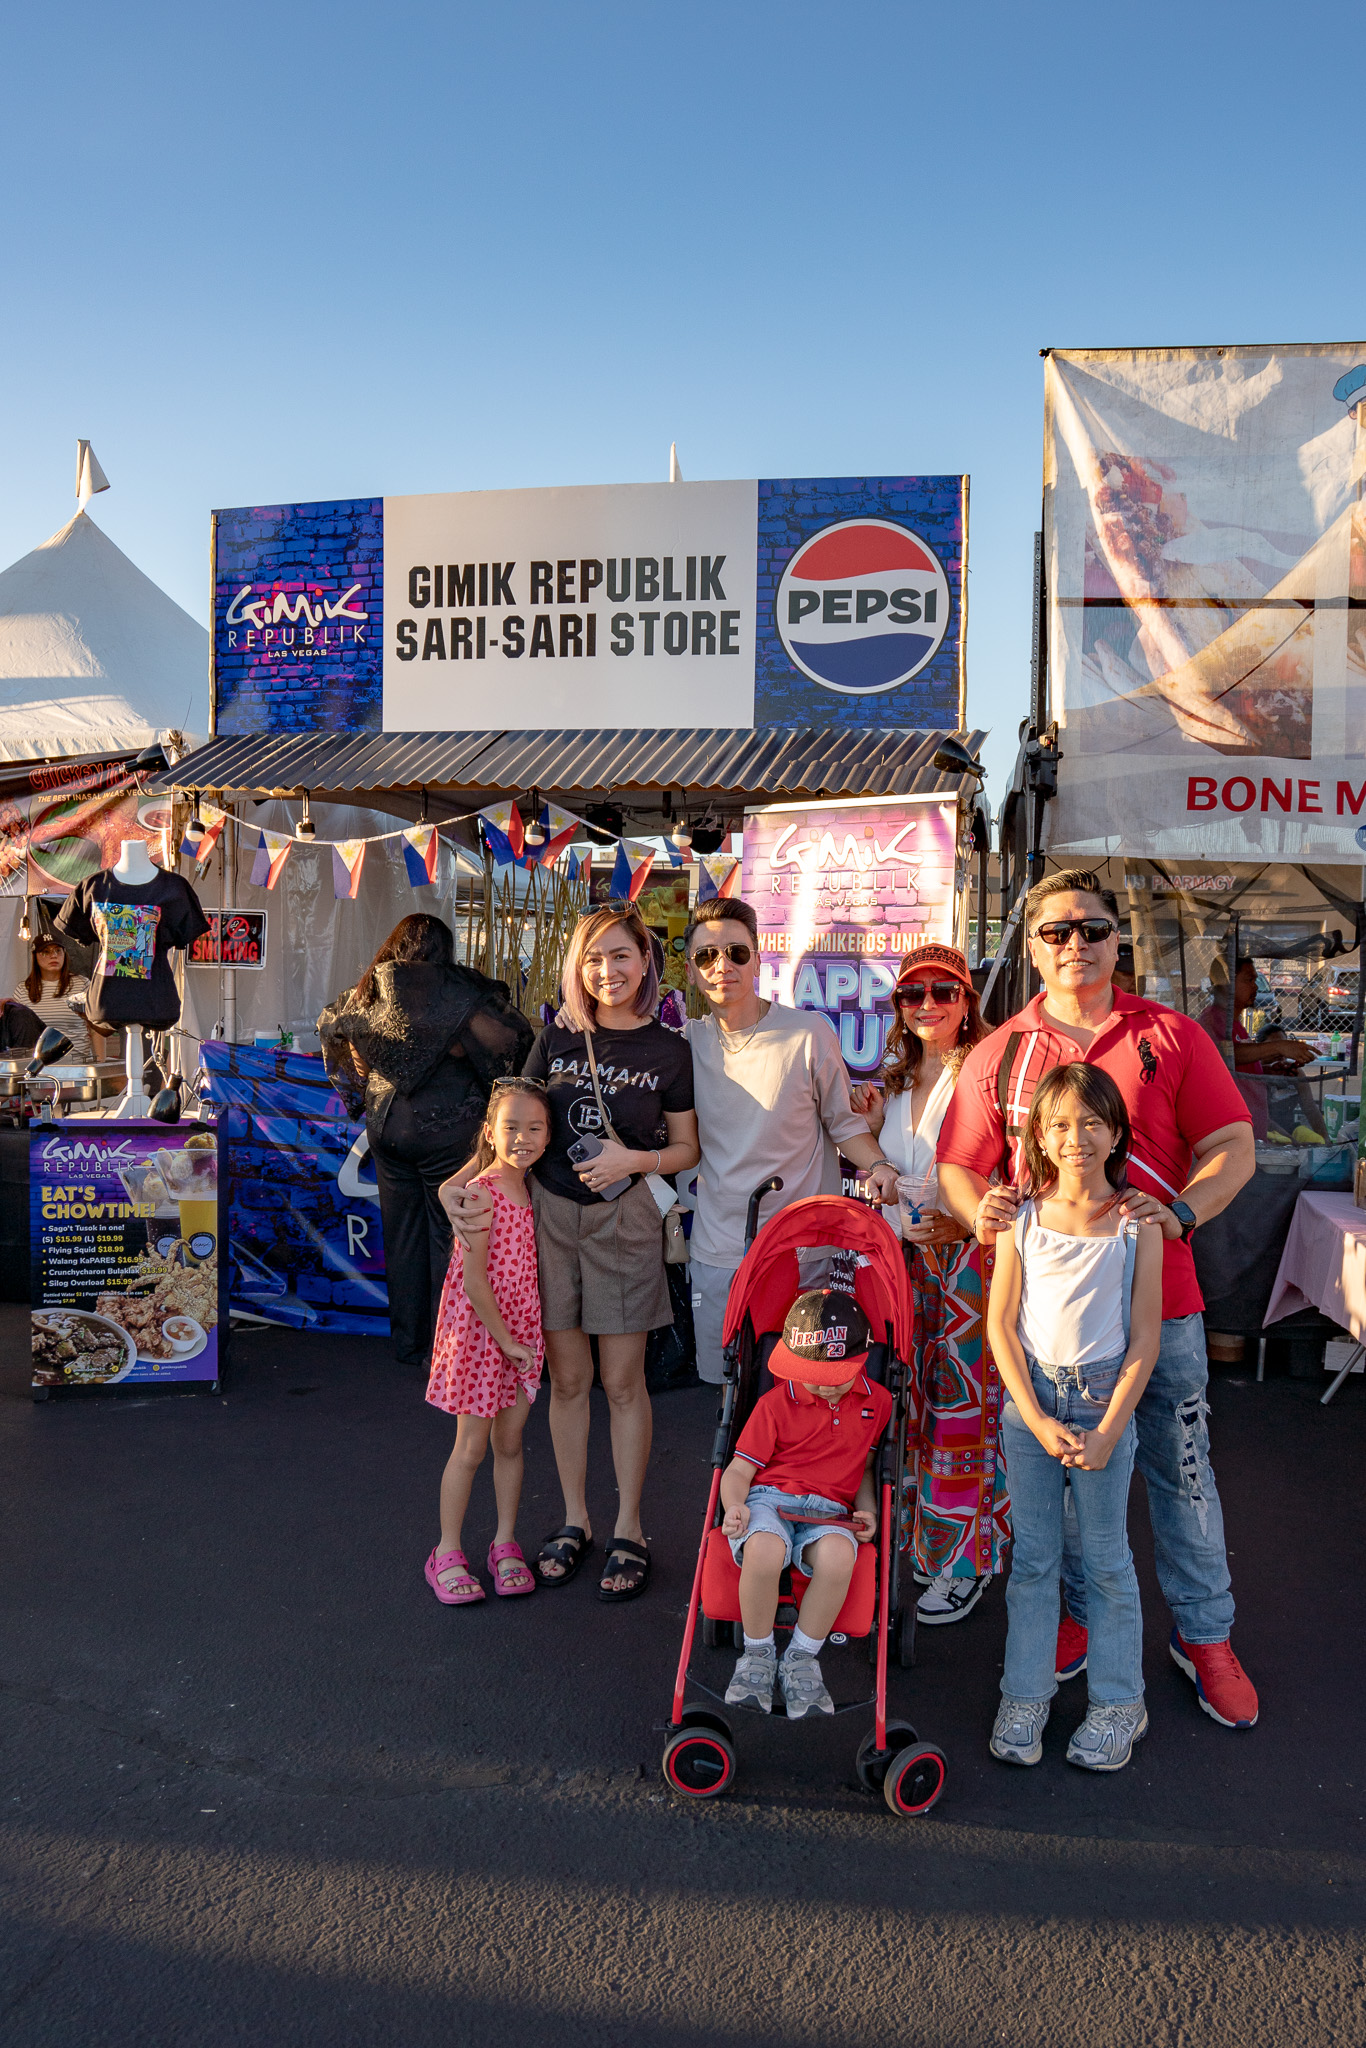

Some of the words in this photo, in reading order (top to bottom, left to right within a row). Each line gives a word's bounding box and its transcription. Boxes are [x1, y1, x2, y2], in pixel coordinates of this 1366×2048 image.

[408, 561, 517, 609] GIMIK
[530, 555, 728, 605] REPUBLIK
[788, 588, 938, 625] PEPSI
[228, 624, 366, 648] REPUBLIK
[396, 613, 597, 662] SARI-SARI
[610, 610, 741, 657] STORE
[52, 794, 71, 802] BEST
[73, 792, 102, 801] INASAL
[127, 788, 153, 797] VEGAS
[1186, 776, 1324, 813] BONE
[770, 868, 921, 894] REUBLIK
[1124, 874, 1145, 889] US
[1152, 875, 1236, 890] PHARMACY
[813, 898, 832, 906] AS
[836, 898, 878, 906] VEGAS
[192, 940, 258, 962] SMOKING
[808, 932, 887, 953] GIMIKEROS
[908, 948, 960, 962] ARMANI
[760, 963, 900, 1010] HAPP
[550, 1057, 659, 1091] BALMAIN
[575, 1079, 618, 1095] PAIS
[44, 1160, 135, 1172] REPUBLIK
[41, 1186, 96, 1202] EAT'S
[42, 1202, 156, 1220] CHOWTIME!
[118, 1256, 143, 1264] $16.99
[49, 1268, 105, 1276] Crunchycharon
[790, 1326, 848, 1349] JORDAN
[827, 1342, 846, 1357] 23
